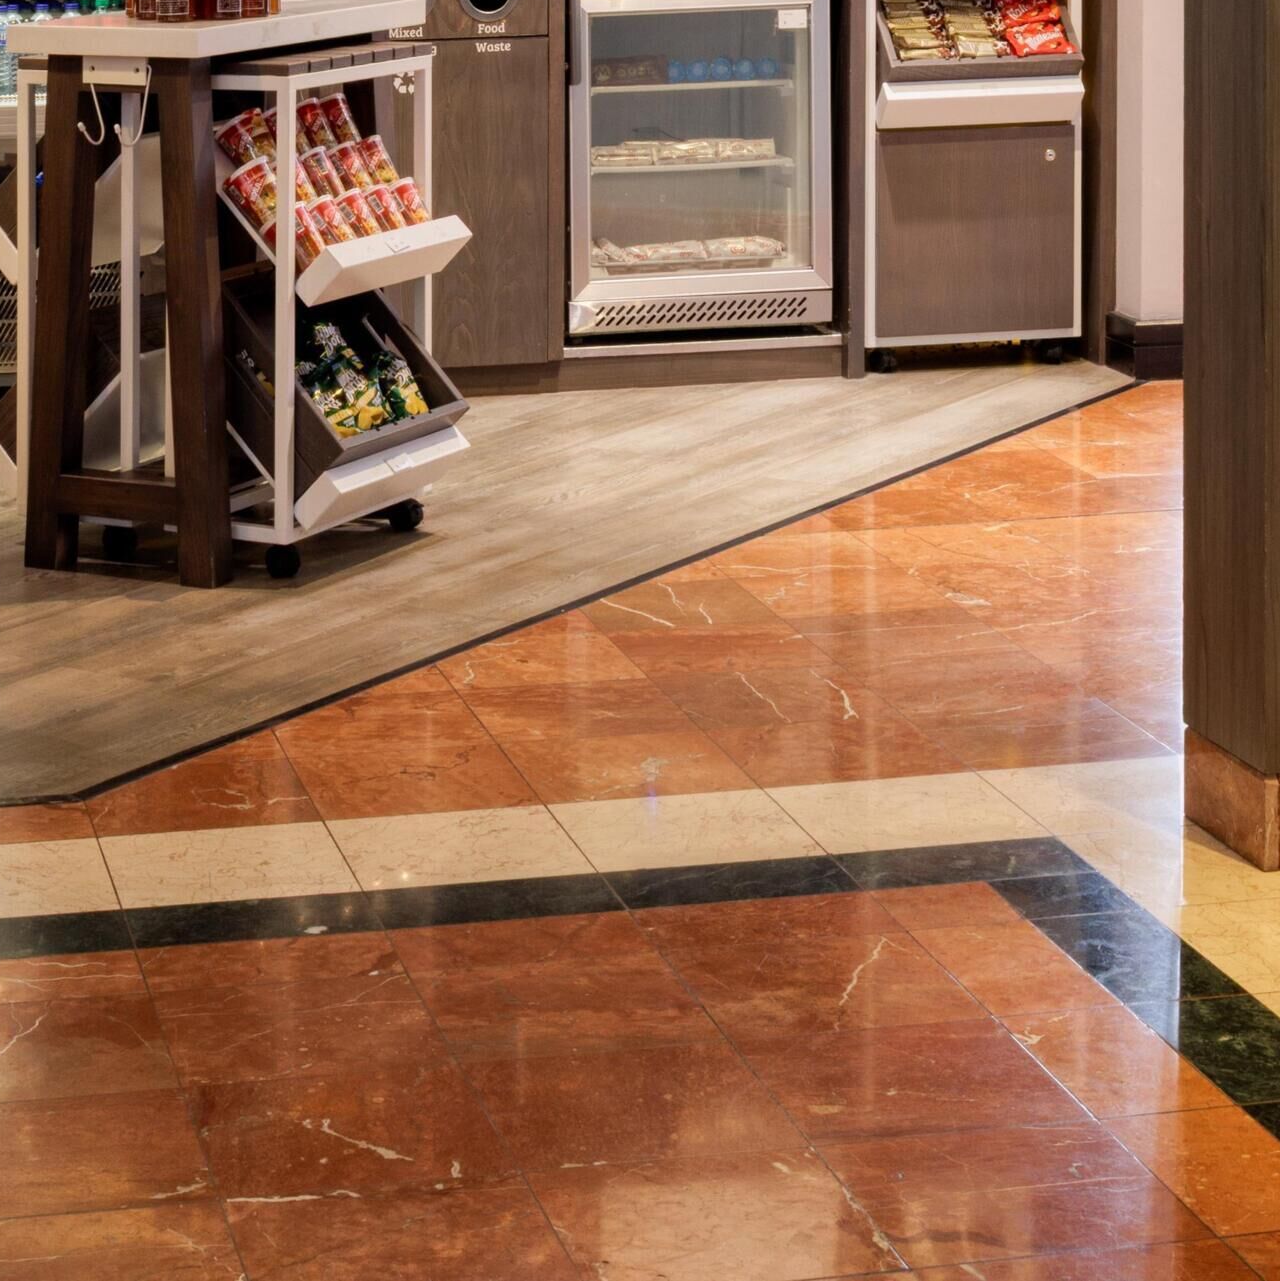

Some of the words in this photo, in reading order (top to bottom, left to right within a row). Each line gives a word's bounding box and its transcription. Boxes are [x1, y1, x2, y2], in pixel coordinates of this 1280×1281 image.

[389, 27, 423, 39] Mixed
[477, 23, 505, 34] Food
[475, 42, 511, 53] Waste
